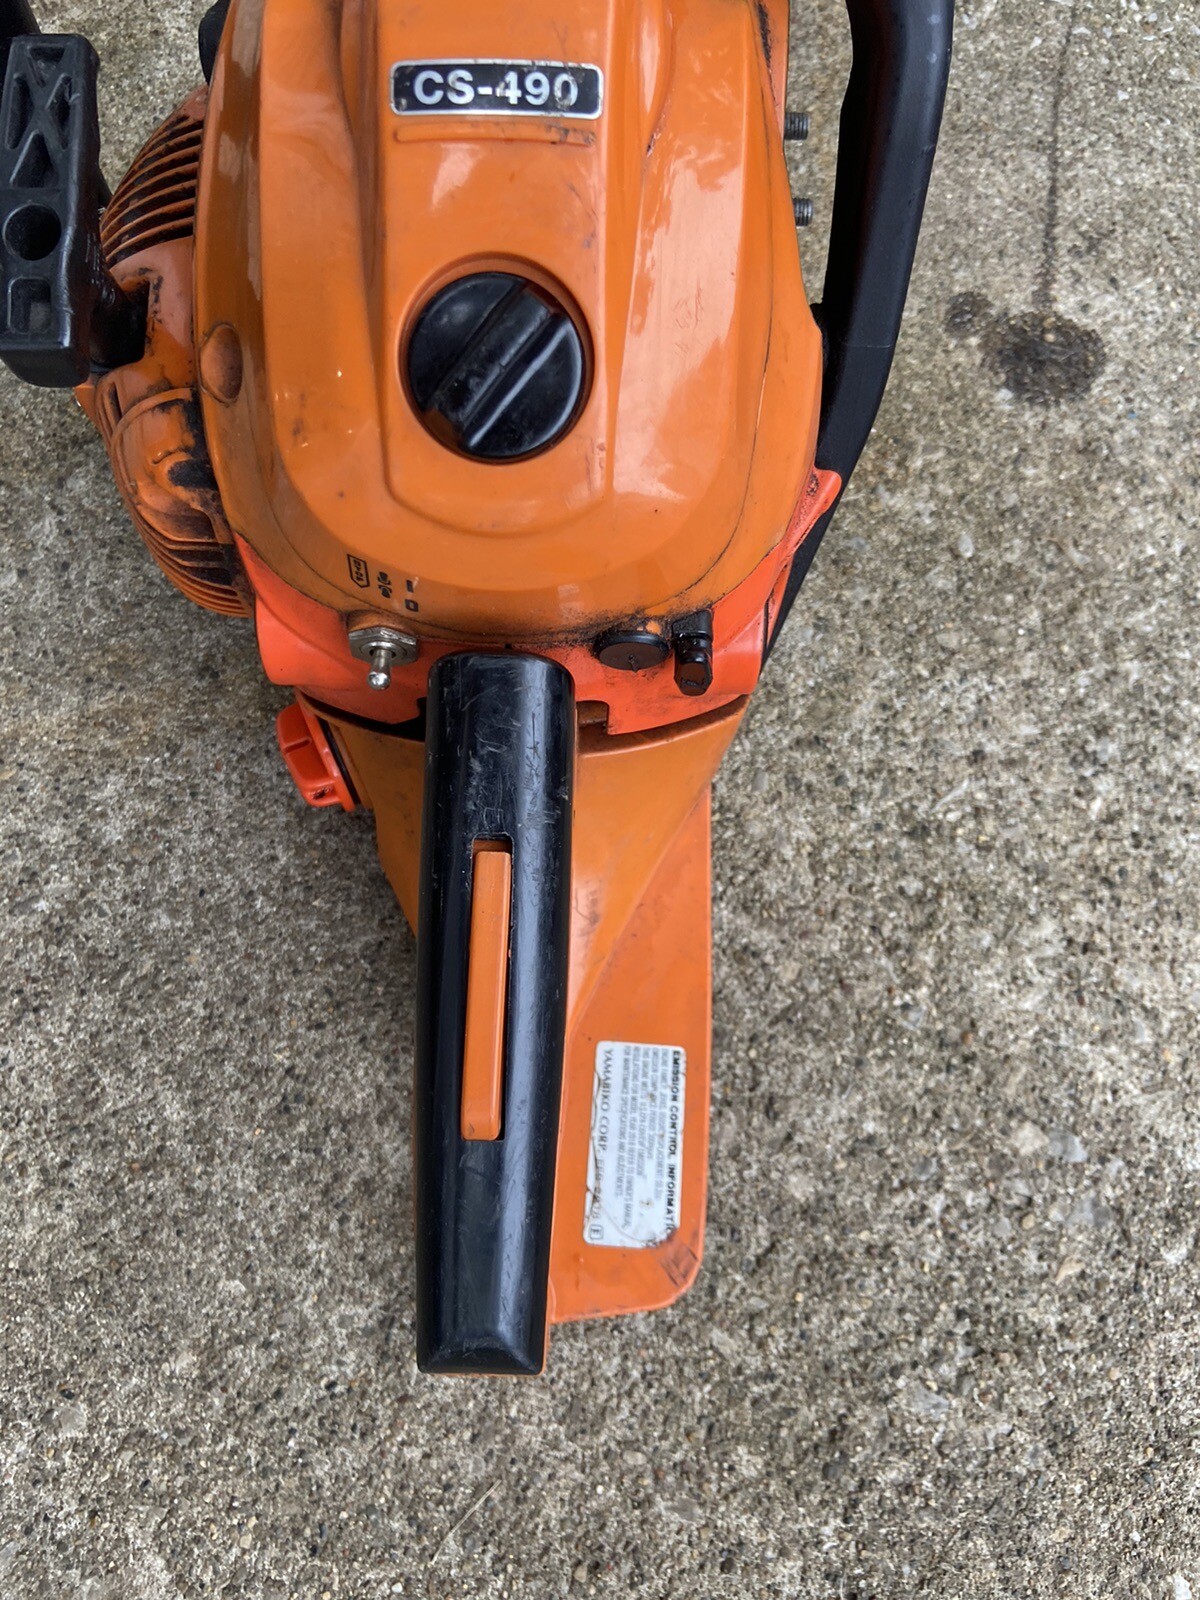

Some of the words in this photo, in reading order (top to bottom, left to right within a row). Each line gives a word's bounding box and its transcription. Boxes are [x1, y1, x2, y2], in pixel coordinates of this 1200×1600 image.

[413, 69, 579, 106] CS-490
[601, 1048, 613, 1111] YAMABIKO
[671, 1050, 680, 1102] EMISSION
[668, 1105, 679, 1159] CONTROL
